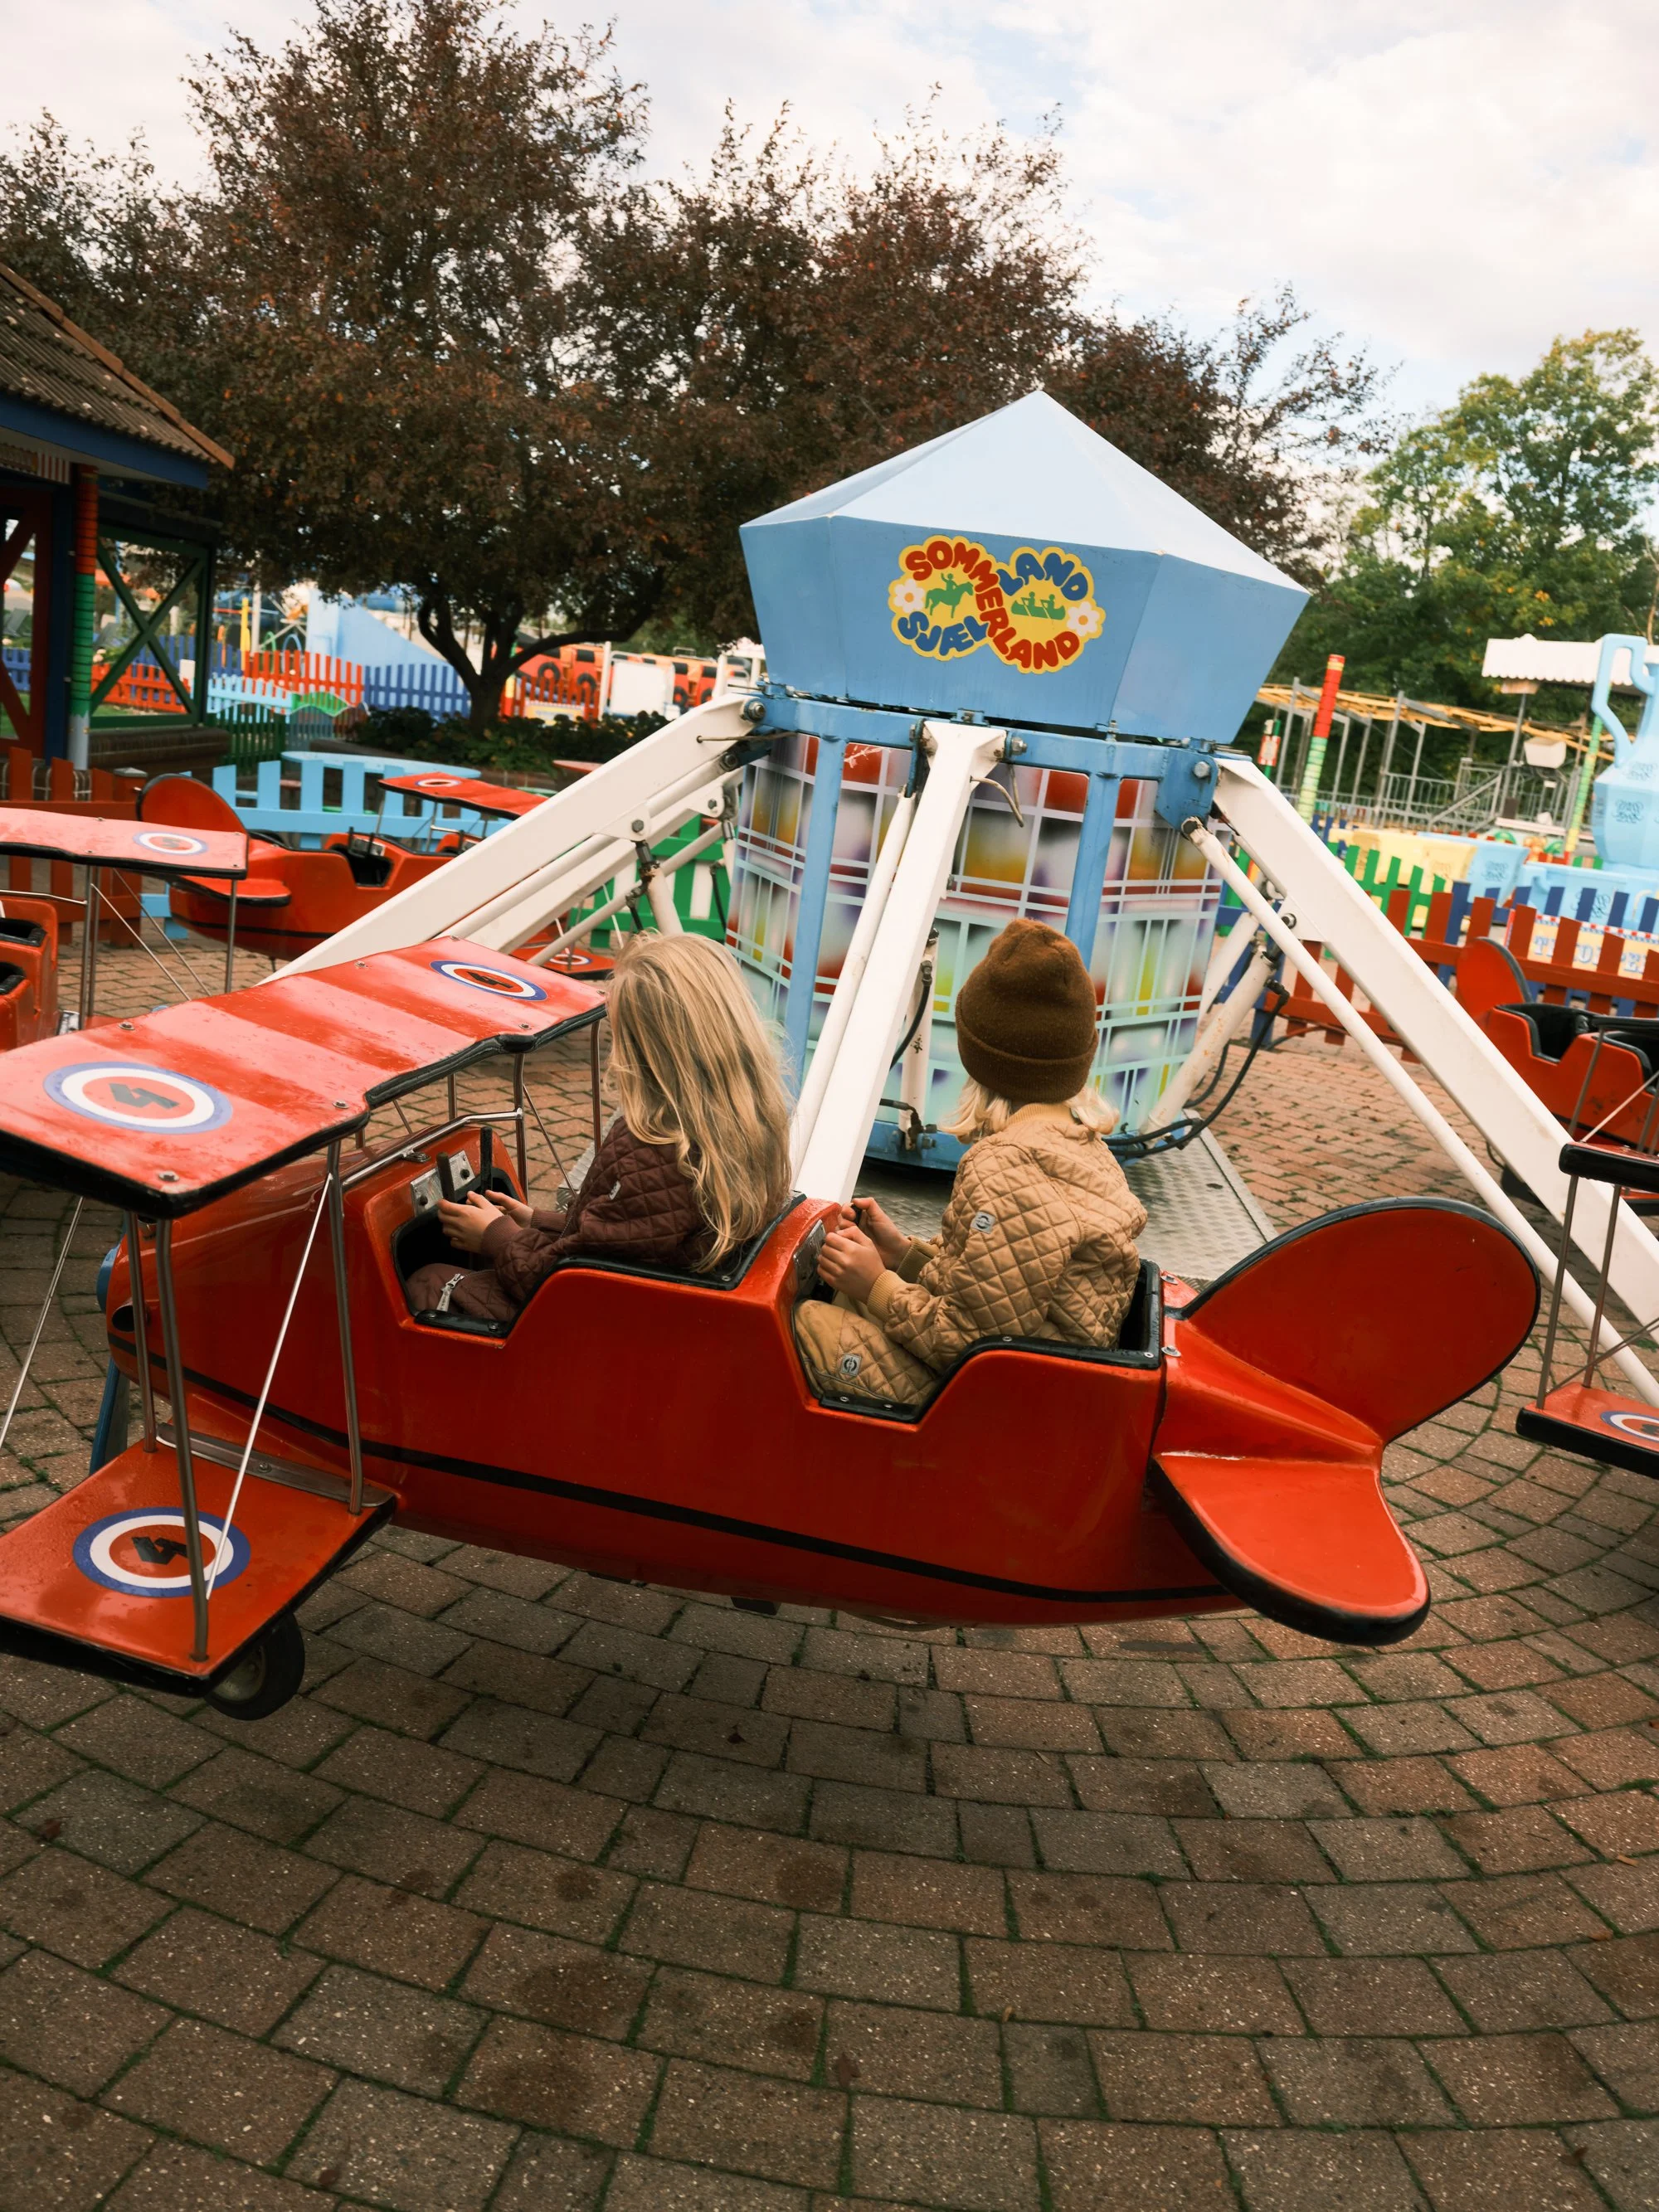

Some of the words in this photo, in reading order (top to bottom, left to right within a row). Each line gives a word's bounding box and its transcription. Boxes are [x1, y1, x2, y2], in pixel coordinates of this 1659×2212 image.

[996, 552, 1088, 600] LAND
[906, 541, 1079, 669] SOMMERLAND
[898, 611, 989, 656] SJÆL
[109, 1083, 179, 1109] 4
